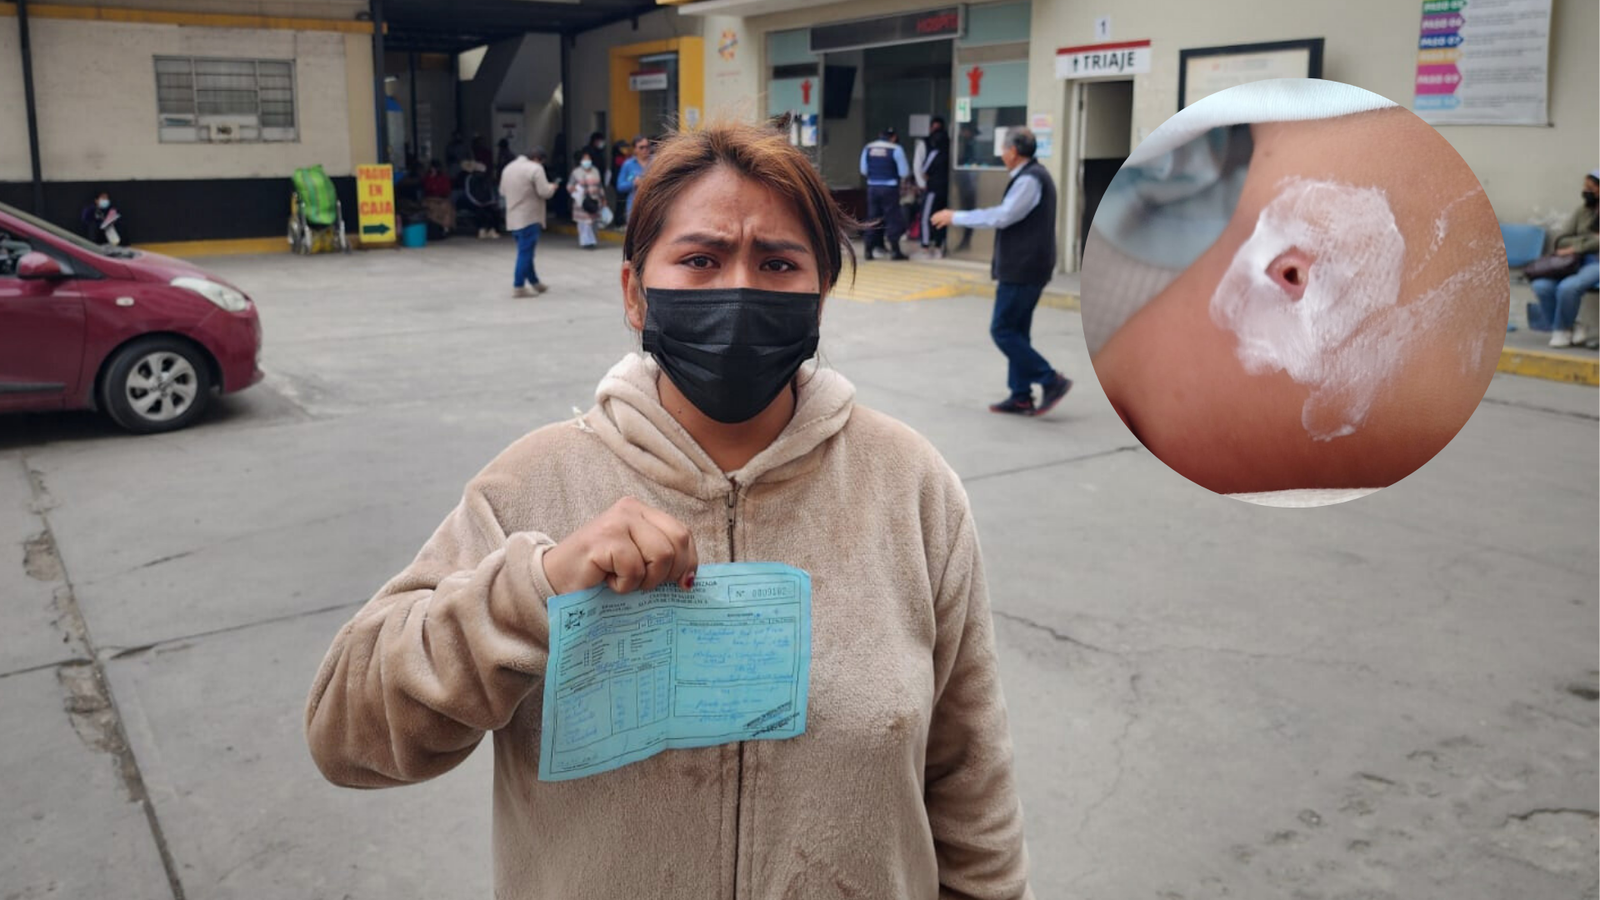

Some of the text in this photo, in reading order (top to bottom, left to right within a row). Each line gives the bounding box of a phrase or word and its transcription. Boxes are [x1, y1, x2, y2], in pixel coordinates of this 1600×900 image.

[1100, 20, 1106, 35] 1
[1083, 50, 1135, 72] TRIAJE
[358, 168, 392, 181] PAGUE
[369, 185, 383, 197] EN
[360, 201, 392, 216] CAJA
